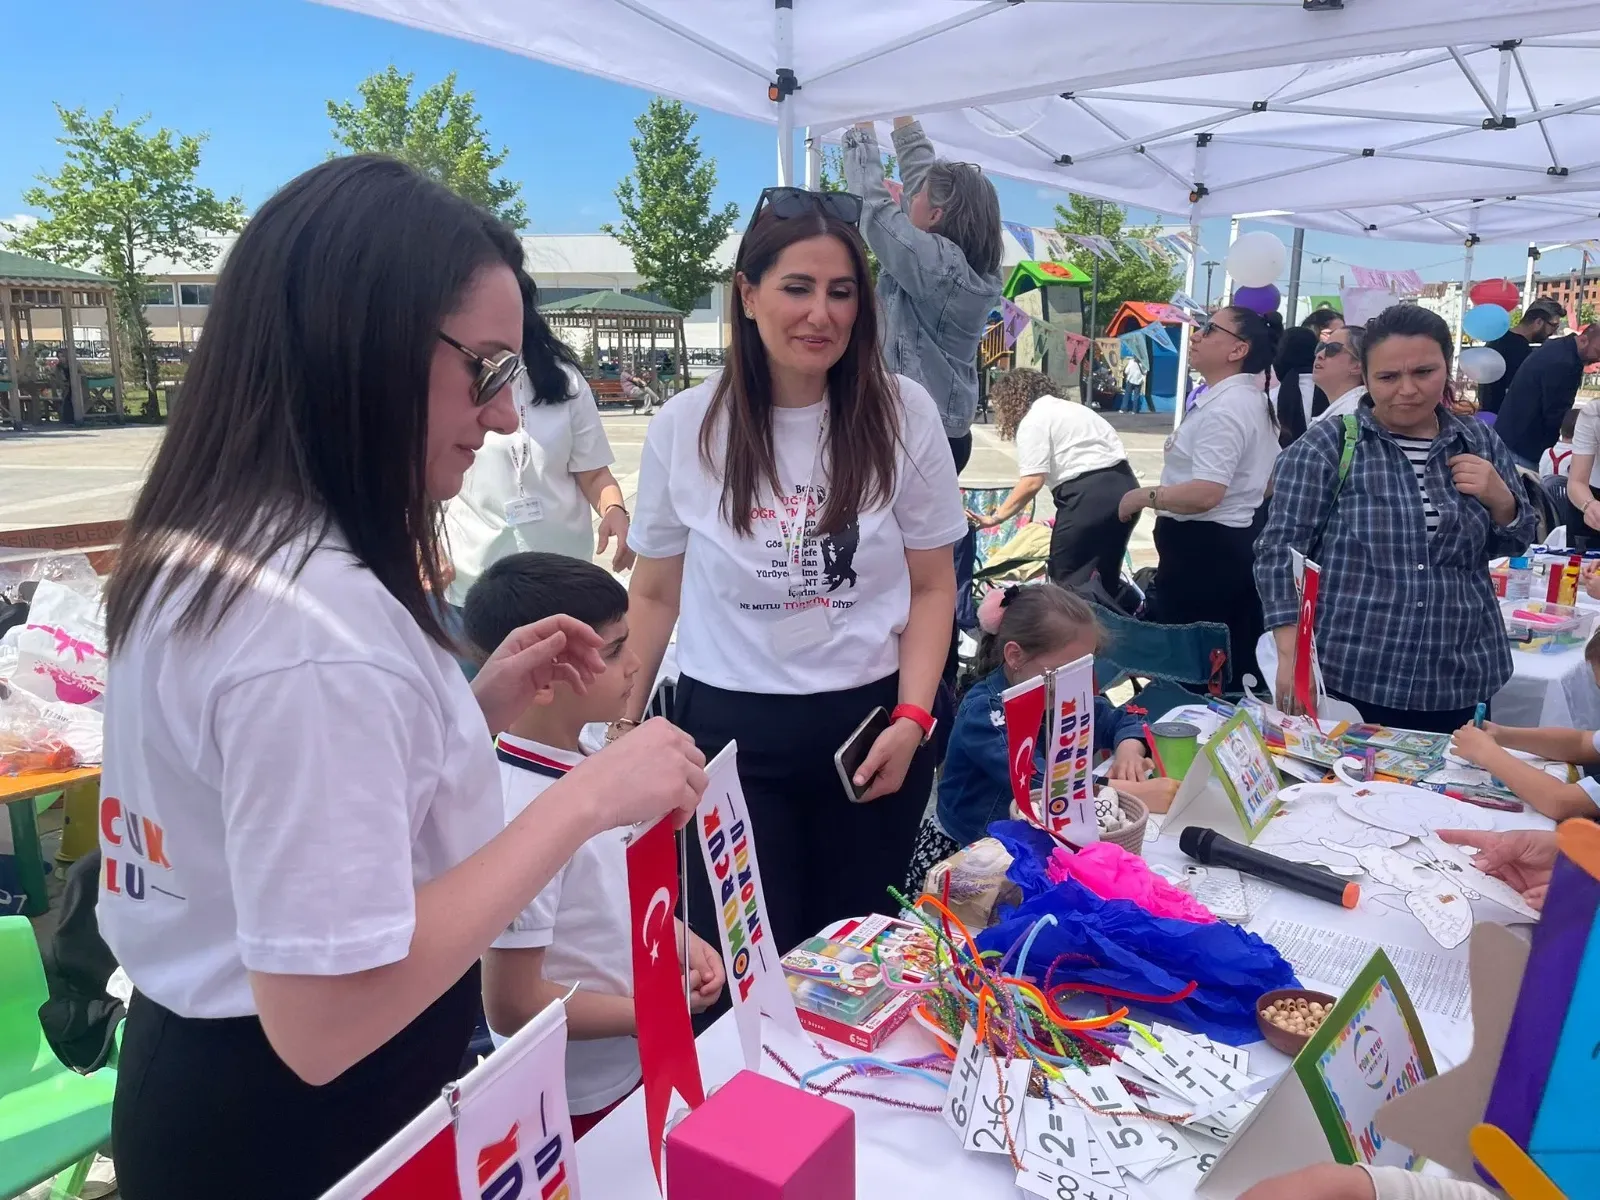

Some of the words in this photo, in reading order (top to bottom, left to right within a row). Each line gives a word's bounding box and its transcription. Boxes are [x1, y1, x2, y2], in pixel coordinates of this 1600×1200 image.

[750, 507, 816, 519] ÖĞRTMN
[1049, 698, 1077, 832] TOMURCUK
[1073, 713, 1090, 801] ANAOKULU
[704, 804, 755, 1002] TOMURCUK
[730, 819, 763, 945] ANAOKULU
